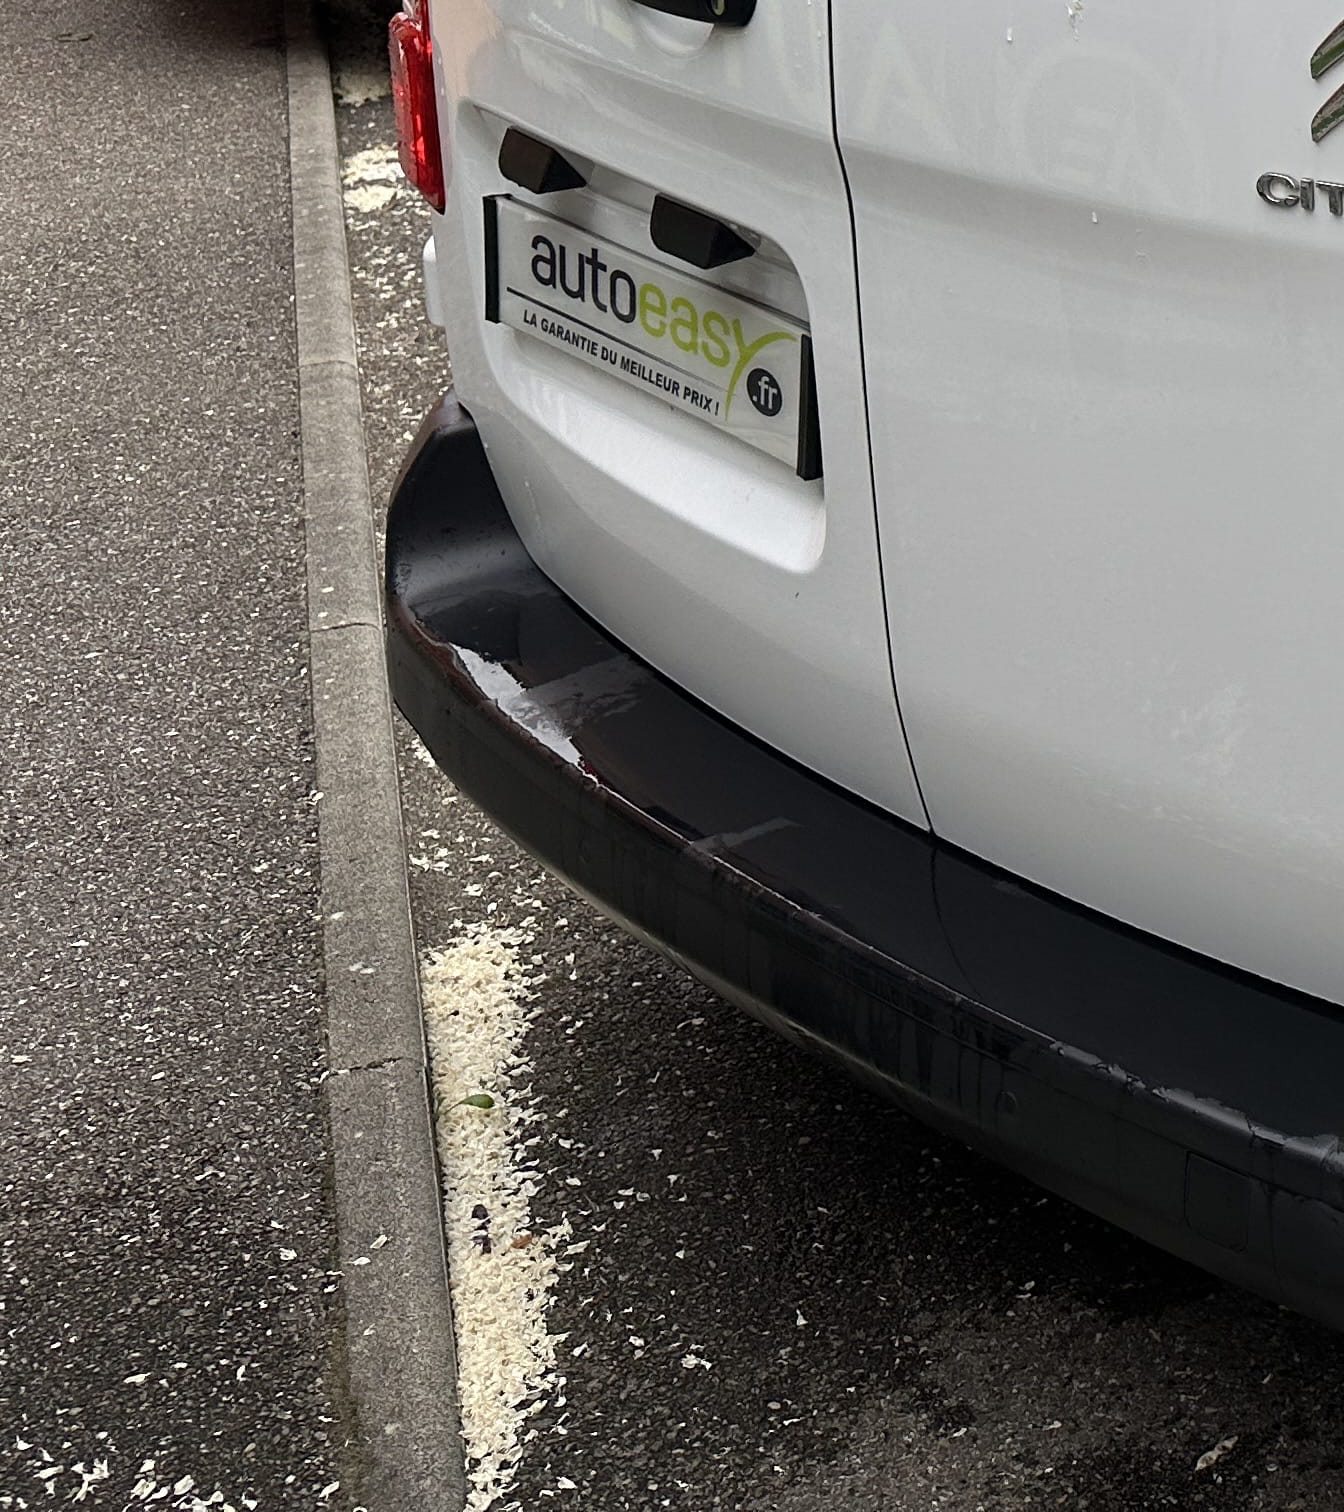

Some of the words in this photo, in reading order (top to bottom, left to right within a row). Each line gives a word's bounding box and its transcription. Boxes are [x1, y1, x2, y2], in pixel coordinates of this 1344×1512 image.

[523, 308, 538, 327] LA
[540, 318, 599, 358] GARANTIE
[601, 345, 617, 366] DU
[619, 354, 680, 398] MEILLEUR
[683, 387, 712, 416] PRIX
[531, 234, 798, 422] autoeasy
